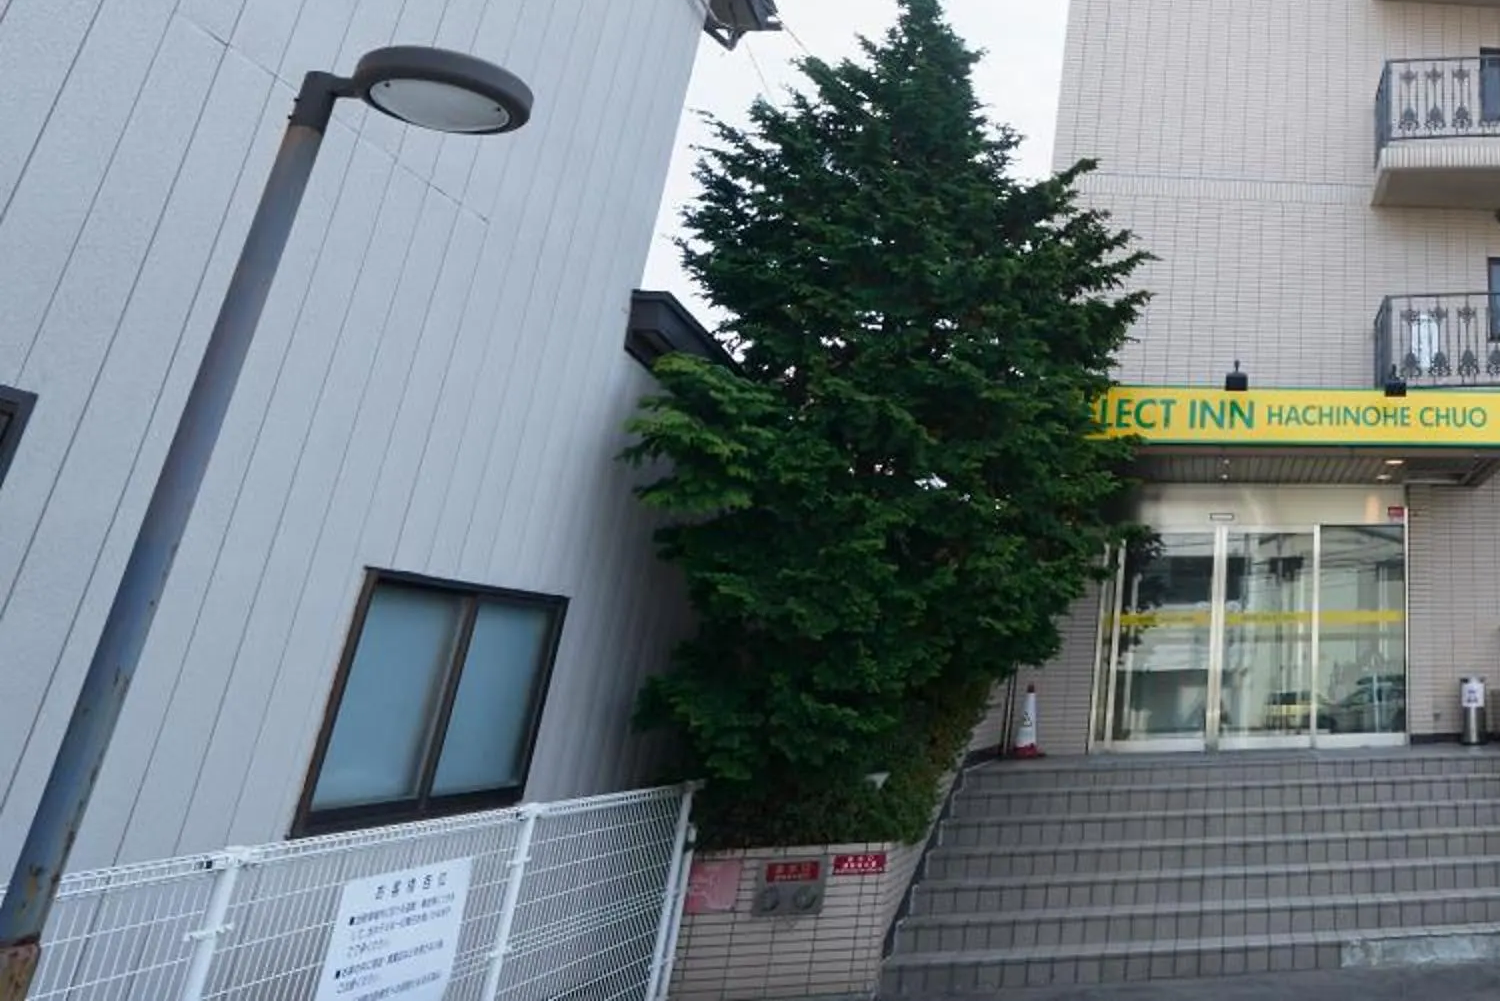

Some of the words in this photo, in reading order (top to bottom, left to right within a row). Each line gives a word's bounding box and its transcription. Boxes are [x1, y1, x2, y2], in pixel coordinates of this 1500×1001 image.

[1101, 398, 1176, 429] LECT
[1188, 400, 1254, 429] INN
[1267, 405, 1410, 427] HACHINOHE
[1419, 406, 1487, 428] CHUO
